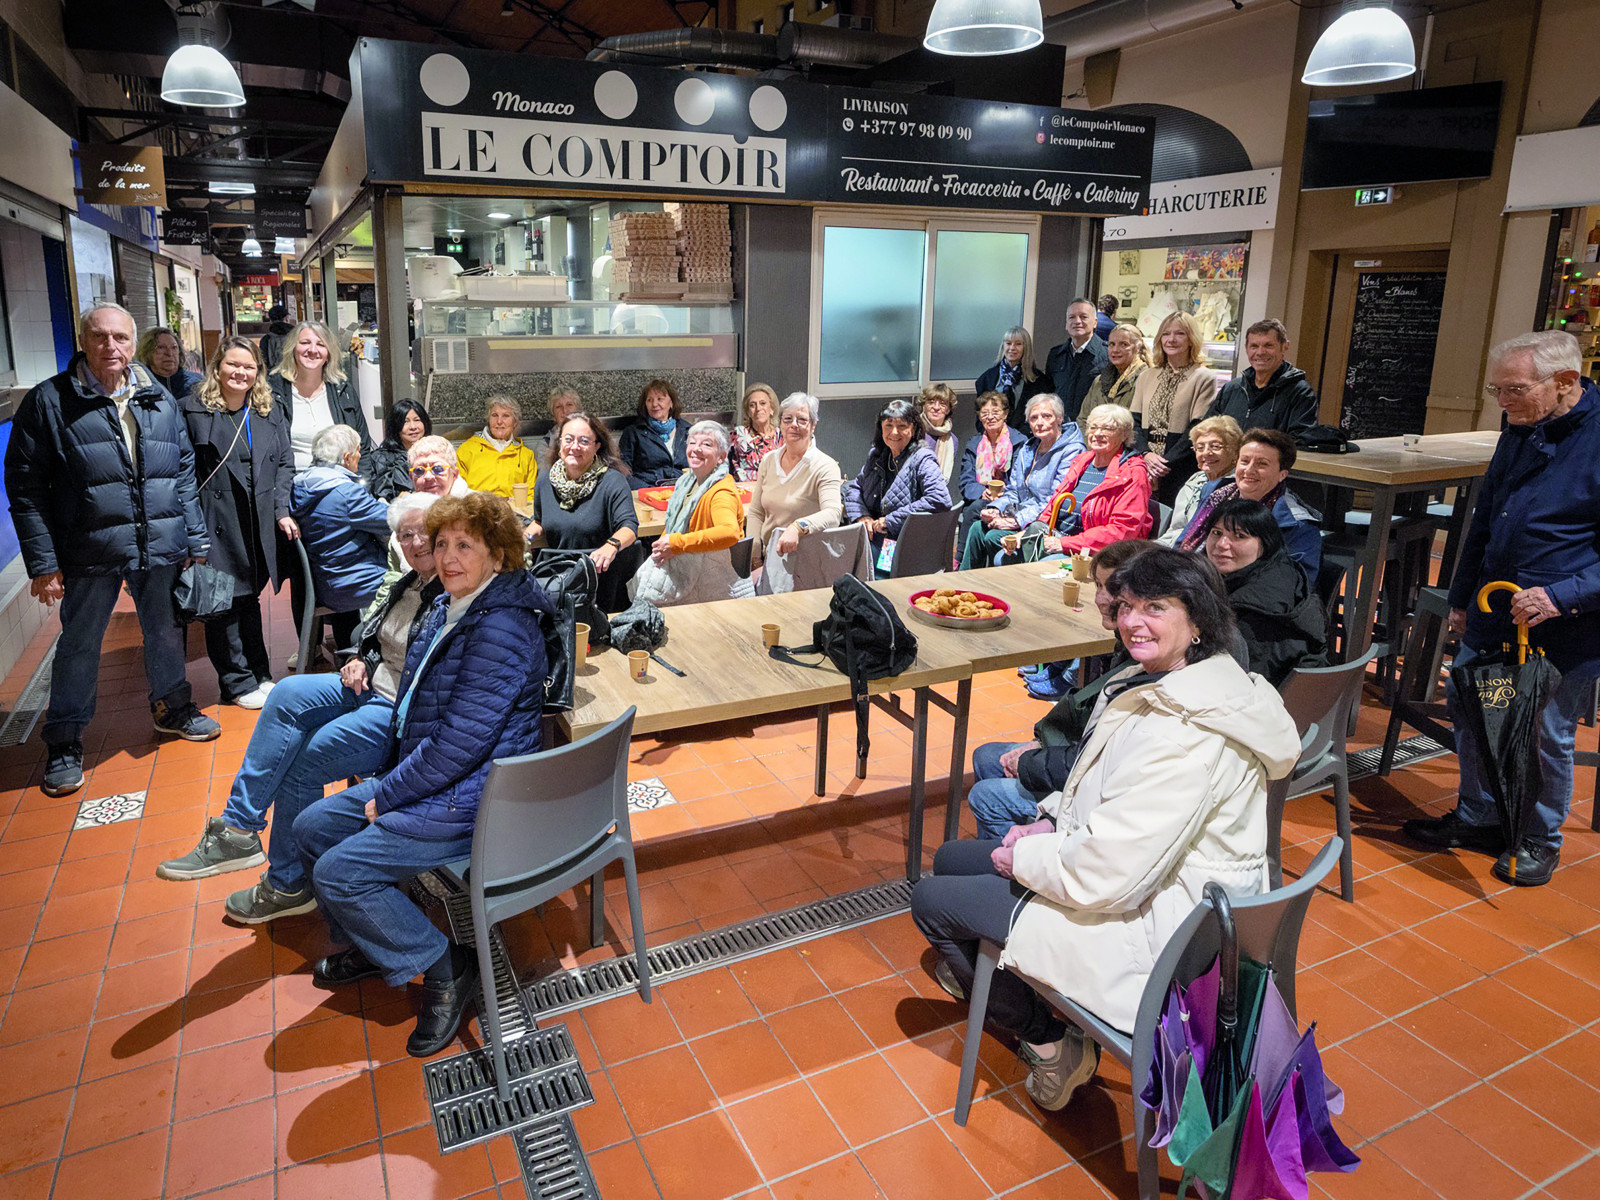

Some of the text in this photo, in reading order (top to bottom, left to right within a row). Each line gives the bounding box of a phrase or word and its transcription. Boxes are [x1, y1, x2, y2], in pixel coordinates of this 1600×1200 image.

[492, 91, 575, 116] Monaco
[843, 98, 909, 115] LIVRAISON
[860, 119, 972, 141] +377 97 98 09 90
[1051, 115, 1146, 134] @leComptoirMonaco
[1050, 134, 1116, 150] lecomptoir.mc
[100, 160, 147, 173] Produits
[425, 126, 783, 189] LE COMPTOIR
[98, 178, 151, 190] de la mer
[841, 167, 1140, 209] Restaurant Focacceria Caffè Catering
[1148, 186, 1267, 215] HARCUTERIE
